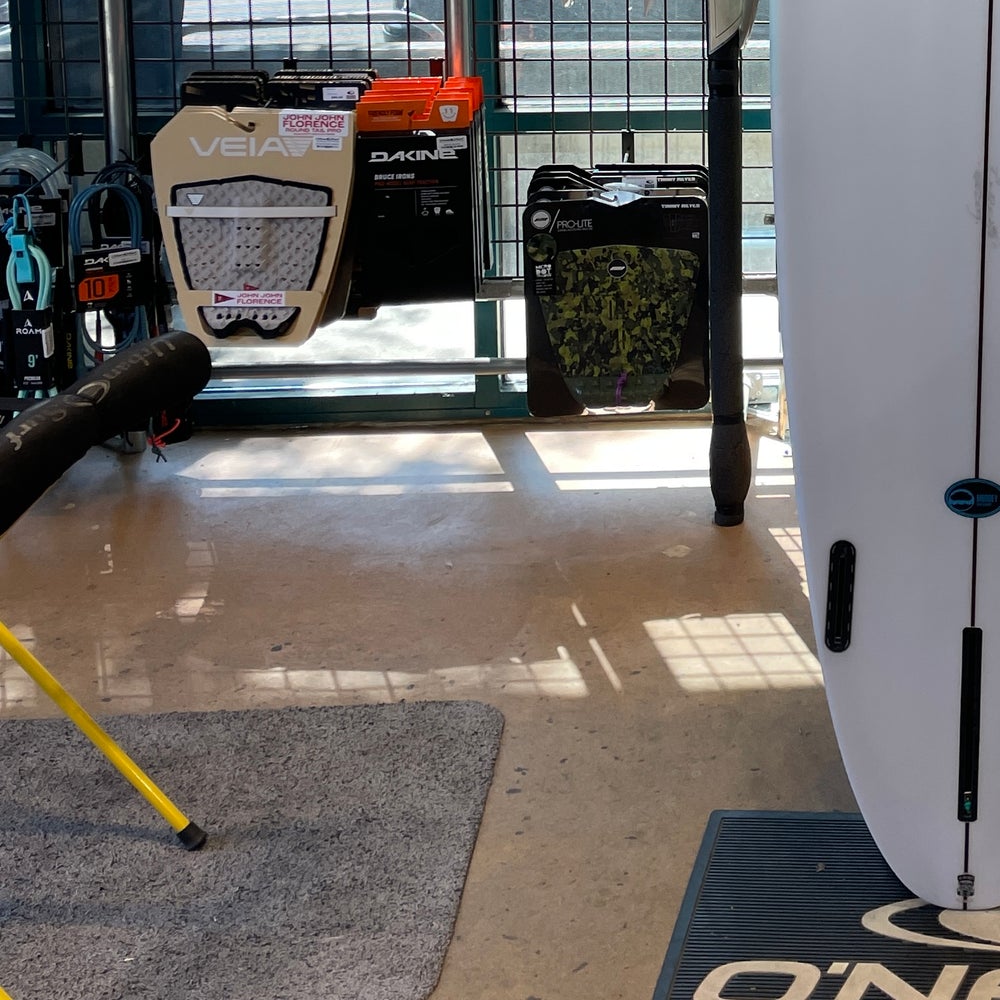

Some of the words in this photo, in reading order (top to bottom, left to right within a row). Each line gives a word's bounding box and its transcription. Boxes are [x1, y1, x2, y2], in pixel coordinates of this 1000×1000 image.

[282, 120, 345, 128] FLORENCE
[368, 149, 459, 162] DAKINE
[395, 172, 415, 180] IRONS
[556, 218, 593, 229] PRO-LITE
[84, 278, 105, 299] 10
